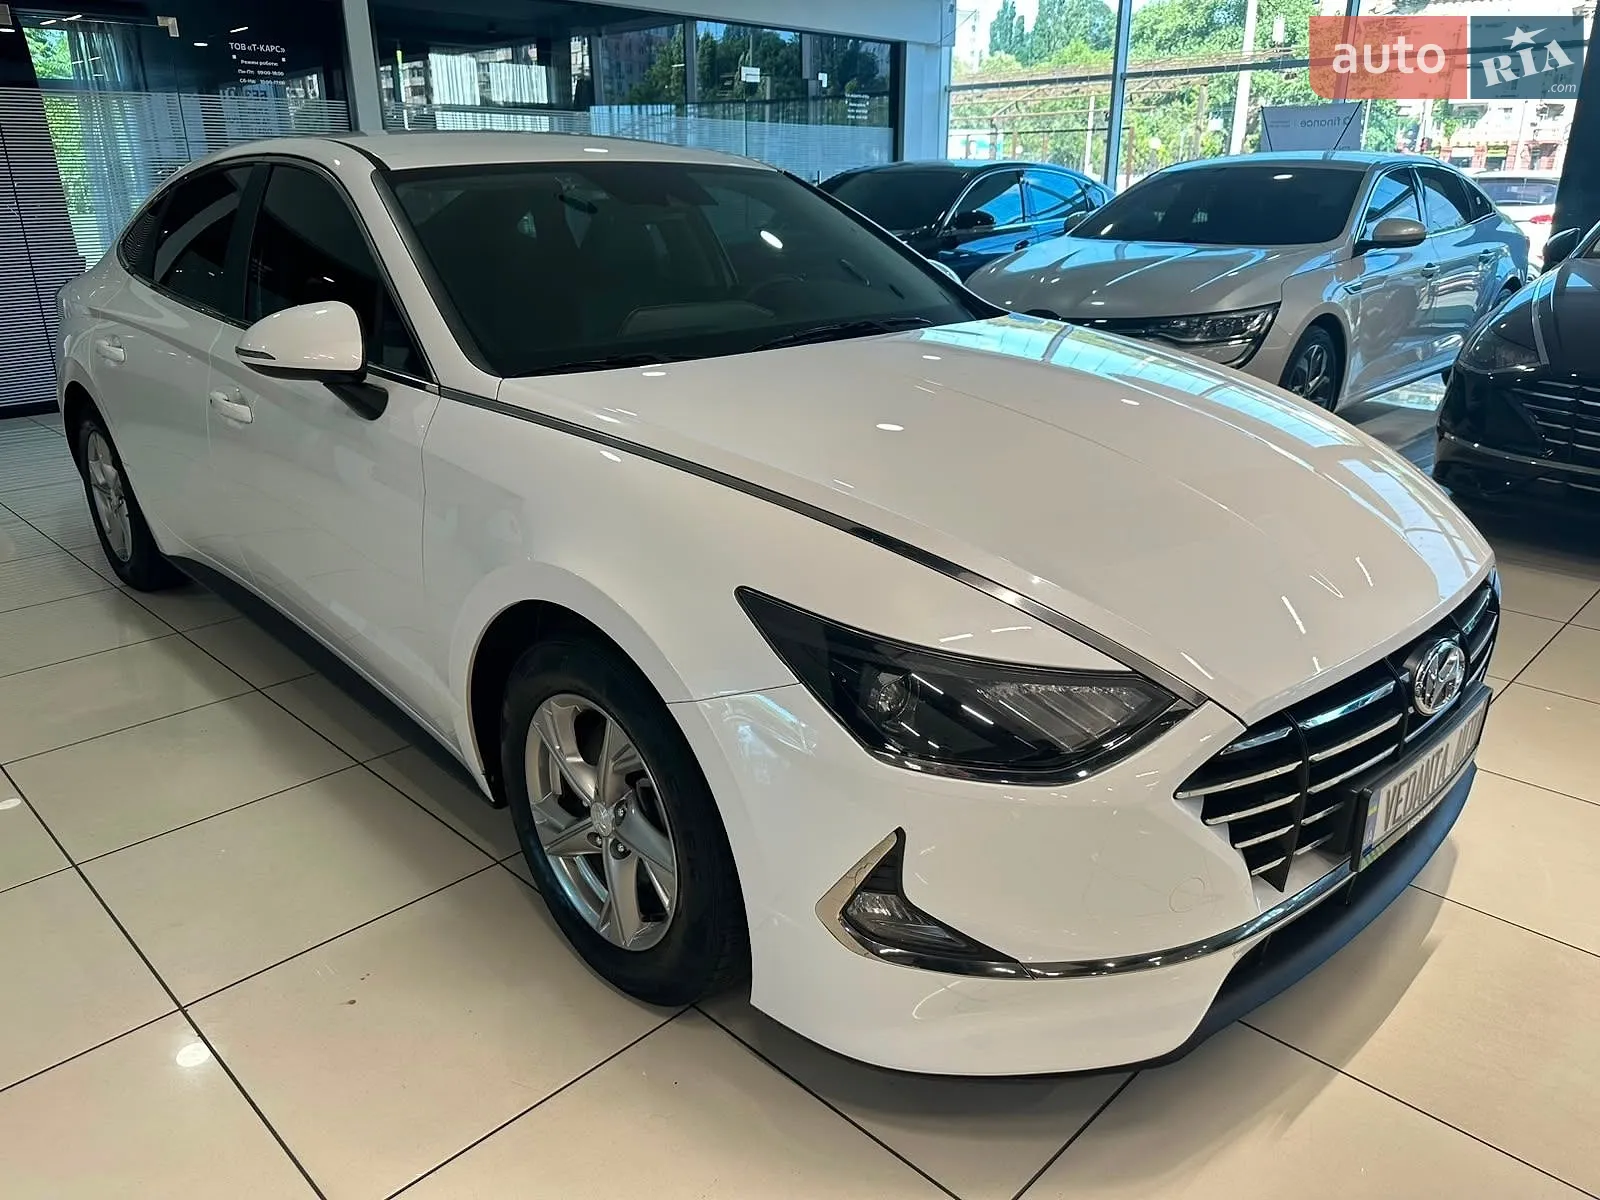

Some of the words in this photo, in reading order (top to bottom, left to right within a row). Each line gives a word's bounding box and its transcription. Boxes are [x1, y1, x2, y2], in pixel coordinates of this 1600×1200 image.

[229, 42, 247, 51] ТОВ
[247, 44, 286, 53] «Т-КАРС»
[1384, 742, 1449, 832] VEDANTA
